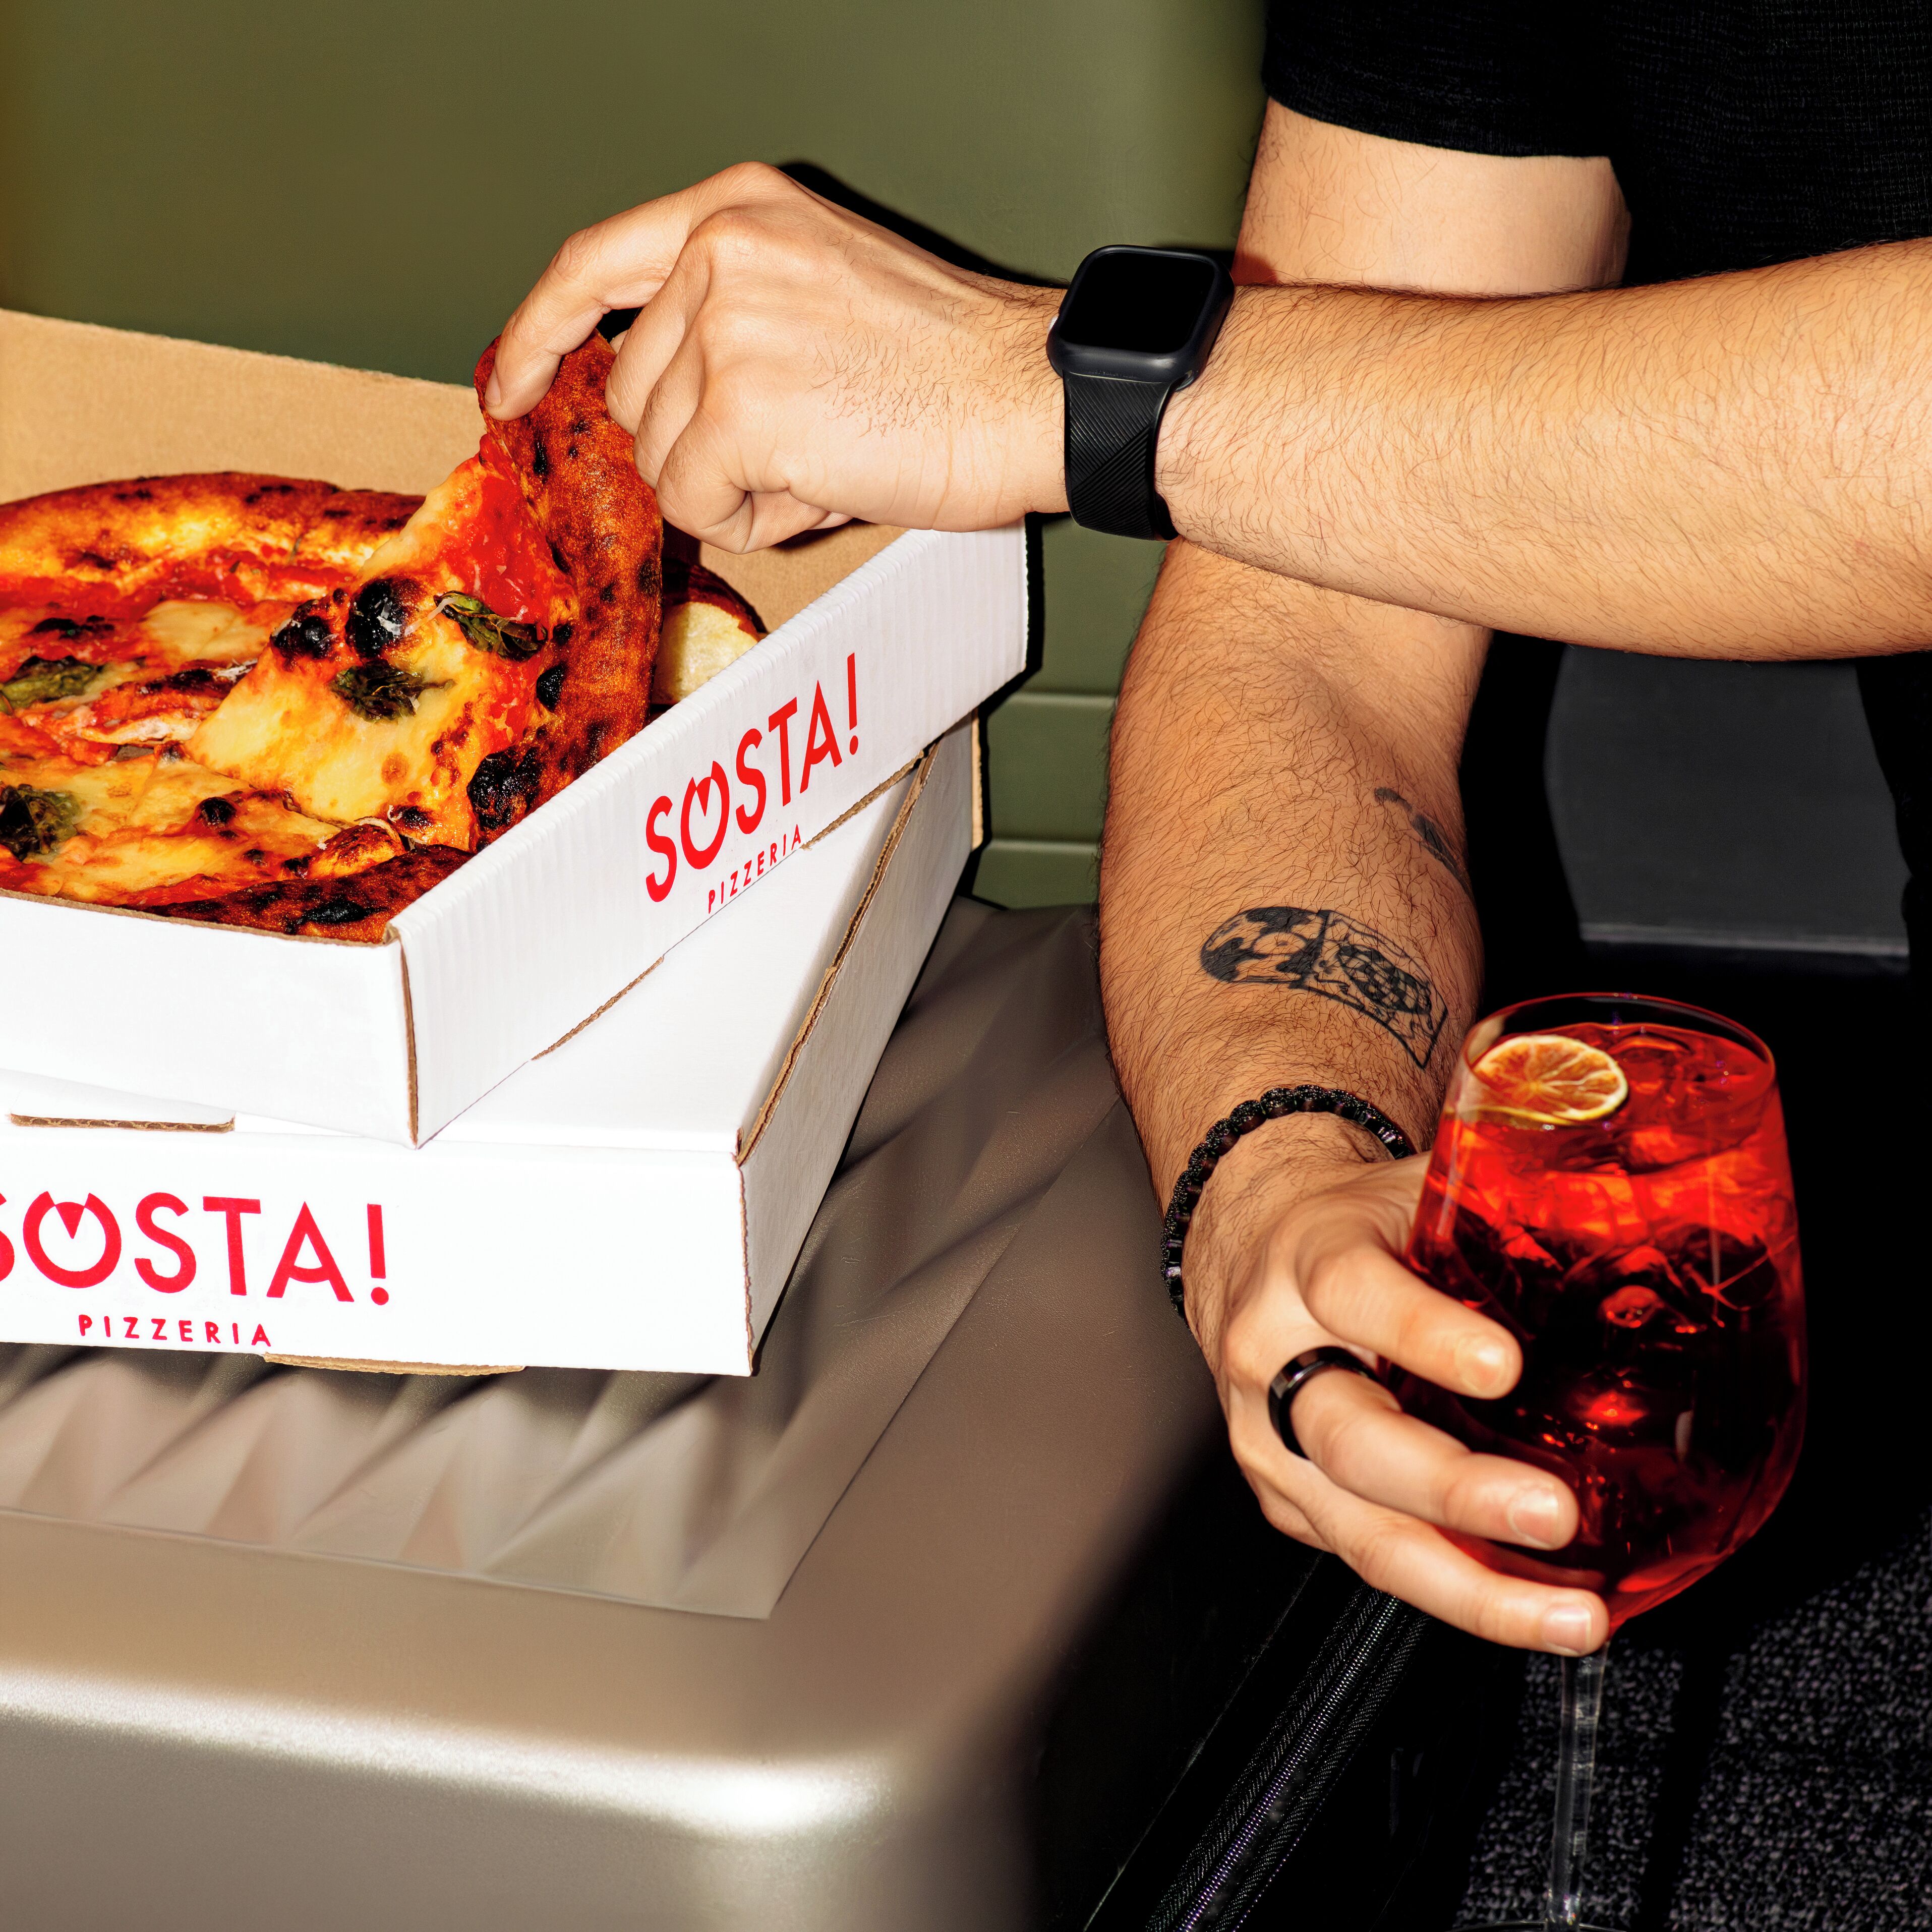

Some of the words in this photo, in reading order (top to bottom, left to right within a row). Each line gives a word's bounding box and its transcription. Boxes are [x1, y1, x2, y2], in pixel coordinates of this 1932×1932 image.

[646, 653, 859, 903] SOSTA!
[708, 824, 801, 914] PIZZERIA
[0, 1191, 389, 1306] OSTA!
[78, 1314, 271, 1347] PIZZERIA
